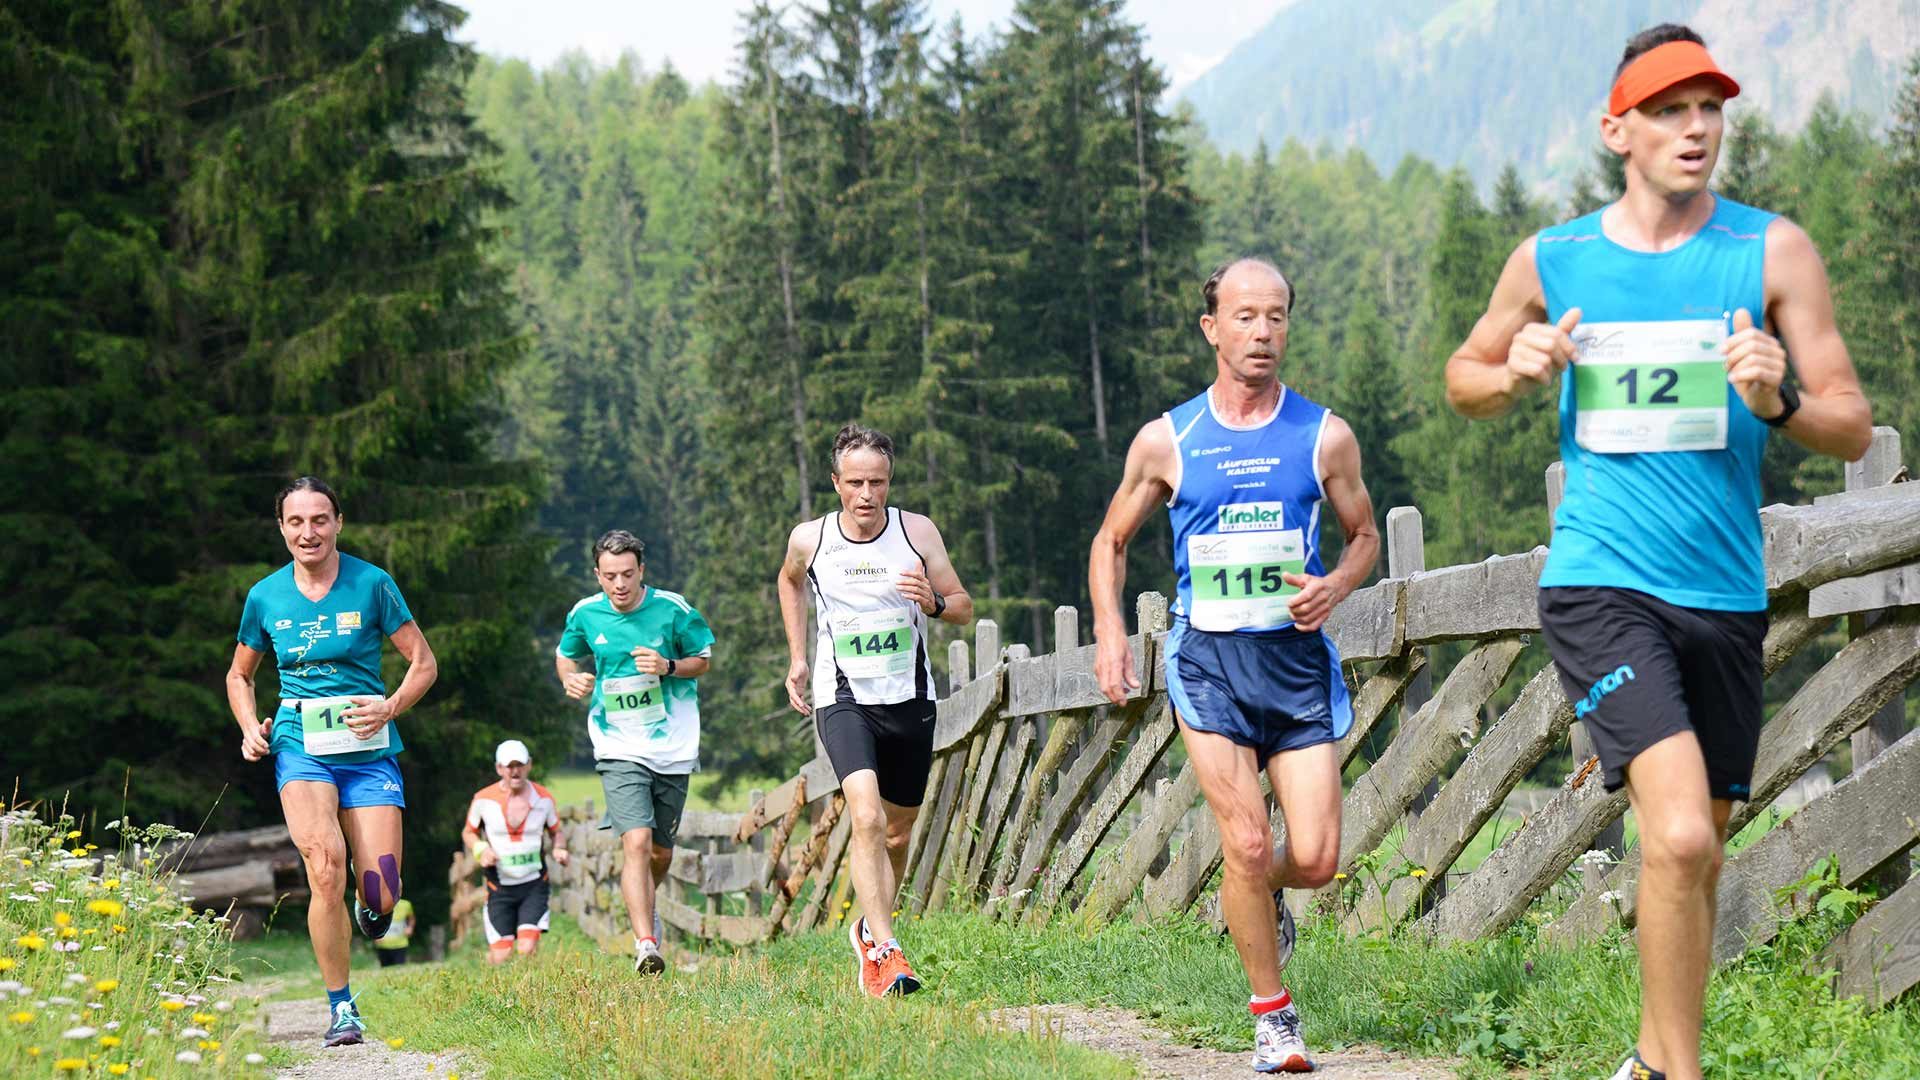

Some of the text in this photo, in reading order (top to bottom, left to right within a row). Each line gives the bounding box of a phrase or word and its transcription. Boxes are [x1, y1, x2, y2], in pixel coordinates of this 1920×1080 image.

[1617, 367, 1679, 404] 12
[1217, 457, 1281, 470] LÄUFERCLUB
[1226, 465, 1272, 477] KALTERN
[1212, 566, 1283, 596] 115
[849, 631, 900, 655] 144
[615, 691, 652, 709] 104
[511, 853, 534, 866] 134
